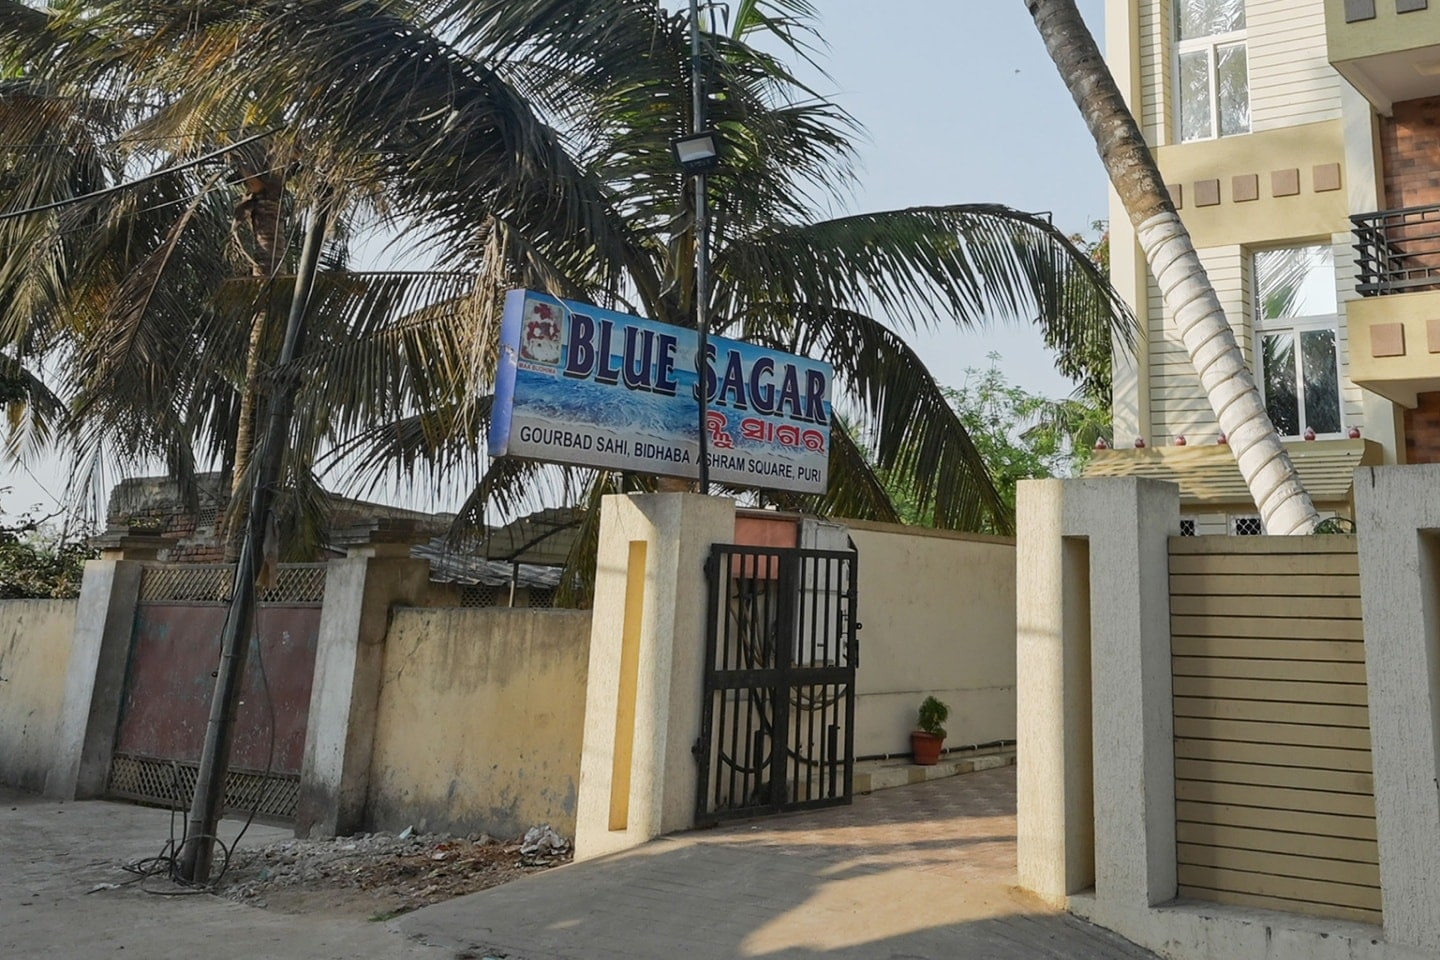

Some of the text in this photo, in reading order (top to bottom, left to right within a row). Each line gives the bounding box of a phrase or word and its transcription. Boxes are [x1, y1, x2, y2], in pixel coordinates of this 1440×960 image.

[564, 313, 828, 426] BLUE SAGAR
[520, 425, 592, 450] GOURBAD
[596, 436, 630, 458] SAHI,
[634, 442, 690, 464] BIDHABA
[748, 459, 795, 480] SQUARE,
[798, 467, 821, 483] PURI
[741, 418, 826, 453] ସାଗର
